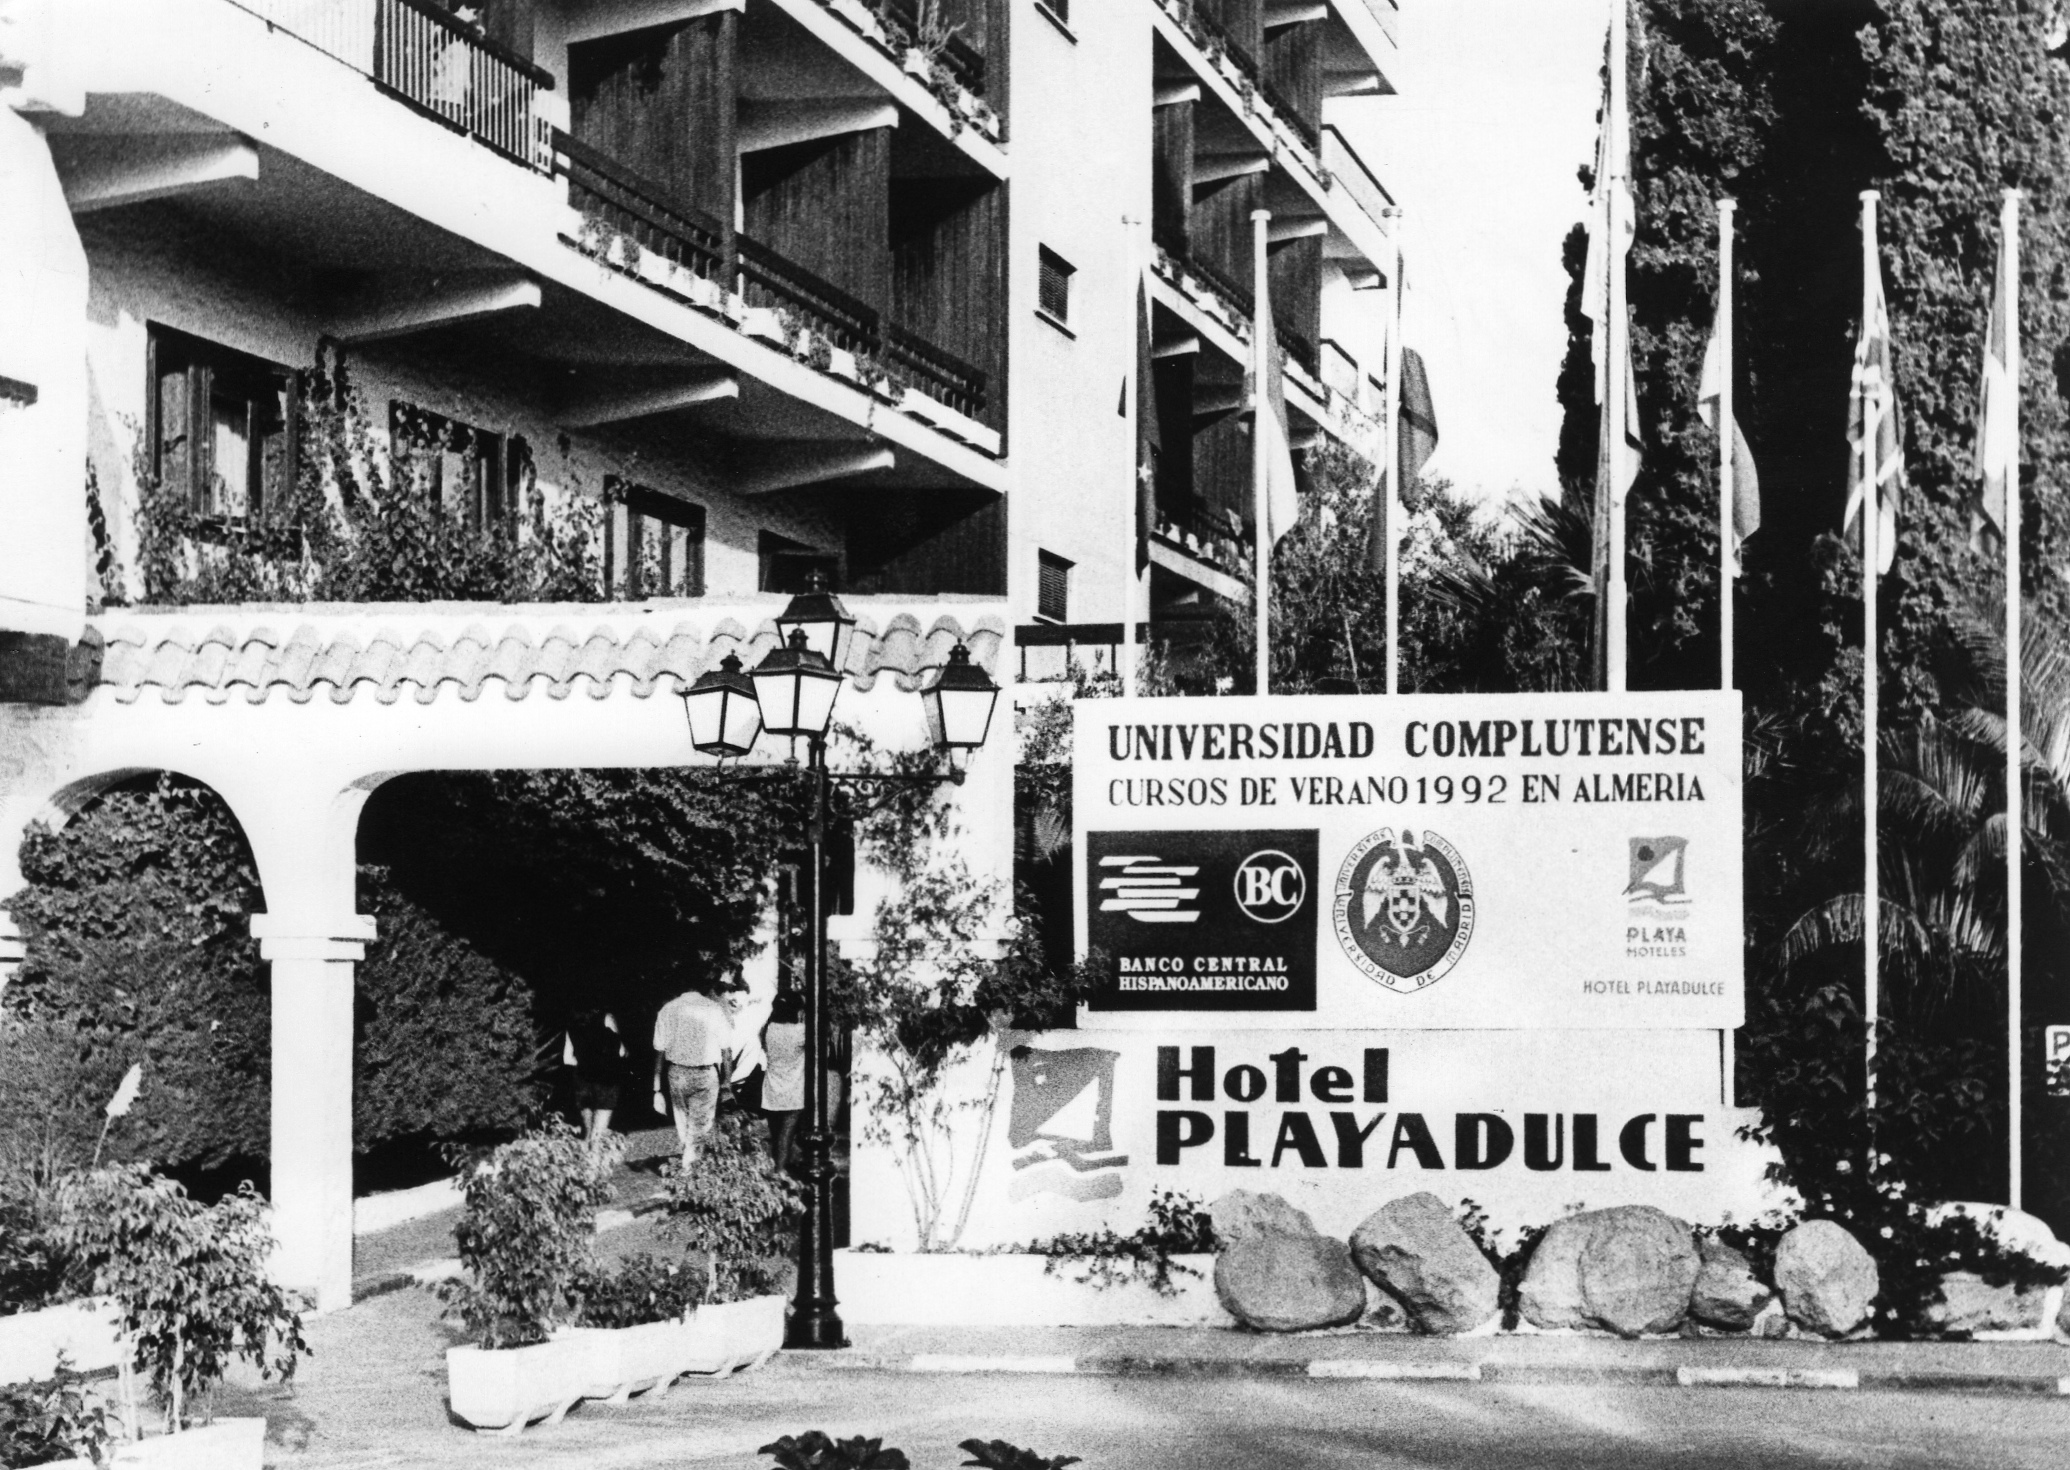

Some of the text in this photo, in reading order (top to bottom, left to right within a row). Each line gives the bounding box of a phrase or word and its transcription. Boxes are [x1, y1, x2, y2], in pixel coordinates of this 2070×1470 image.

[1109, 718, 1704, 760] UNIVERSIDAD COMPLUTENSE
[1110, 773, 1704, 805] CURSOS DE VERANO 1992 EN ALMERIA
[1243, 864, 1297, 907] BC
[1416, 969, 1436, 987] DE
[1445, 903, 1473, 965] MADRID
[1626, 927, 1686, 943] PLAYA
[1121, 958, 1286, 971] BANCO CENTRAL
[1626, 946, 1686, 957] HOTELES
[1120, 977, 1288, 990] HISPANOAMERICANO
[1584, 981, 1724, 995] HOTEL PLAYADULCE
[1157, 1046, 1389, 1103] Hotel
[1157, 1110, 1704, 1172] PLAYADULCE
